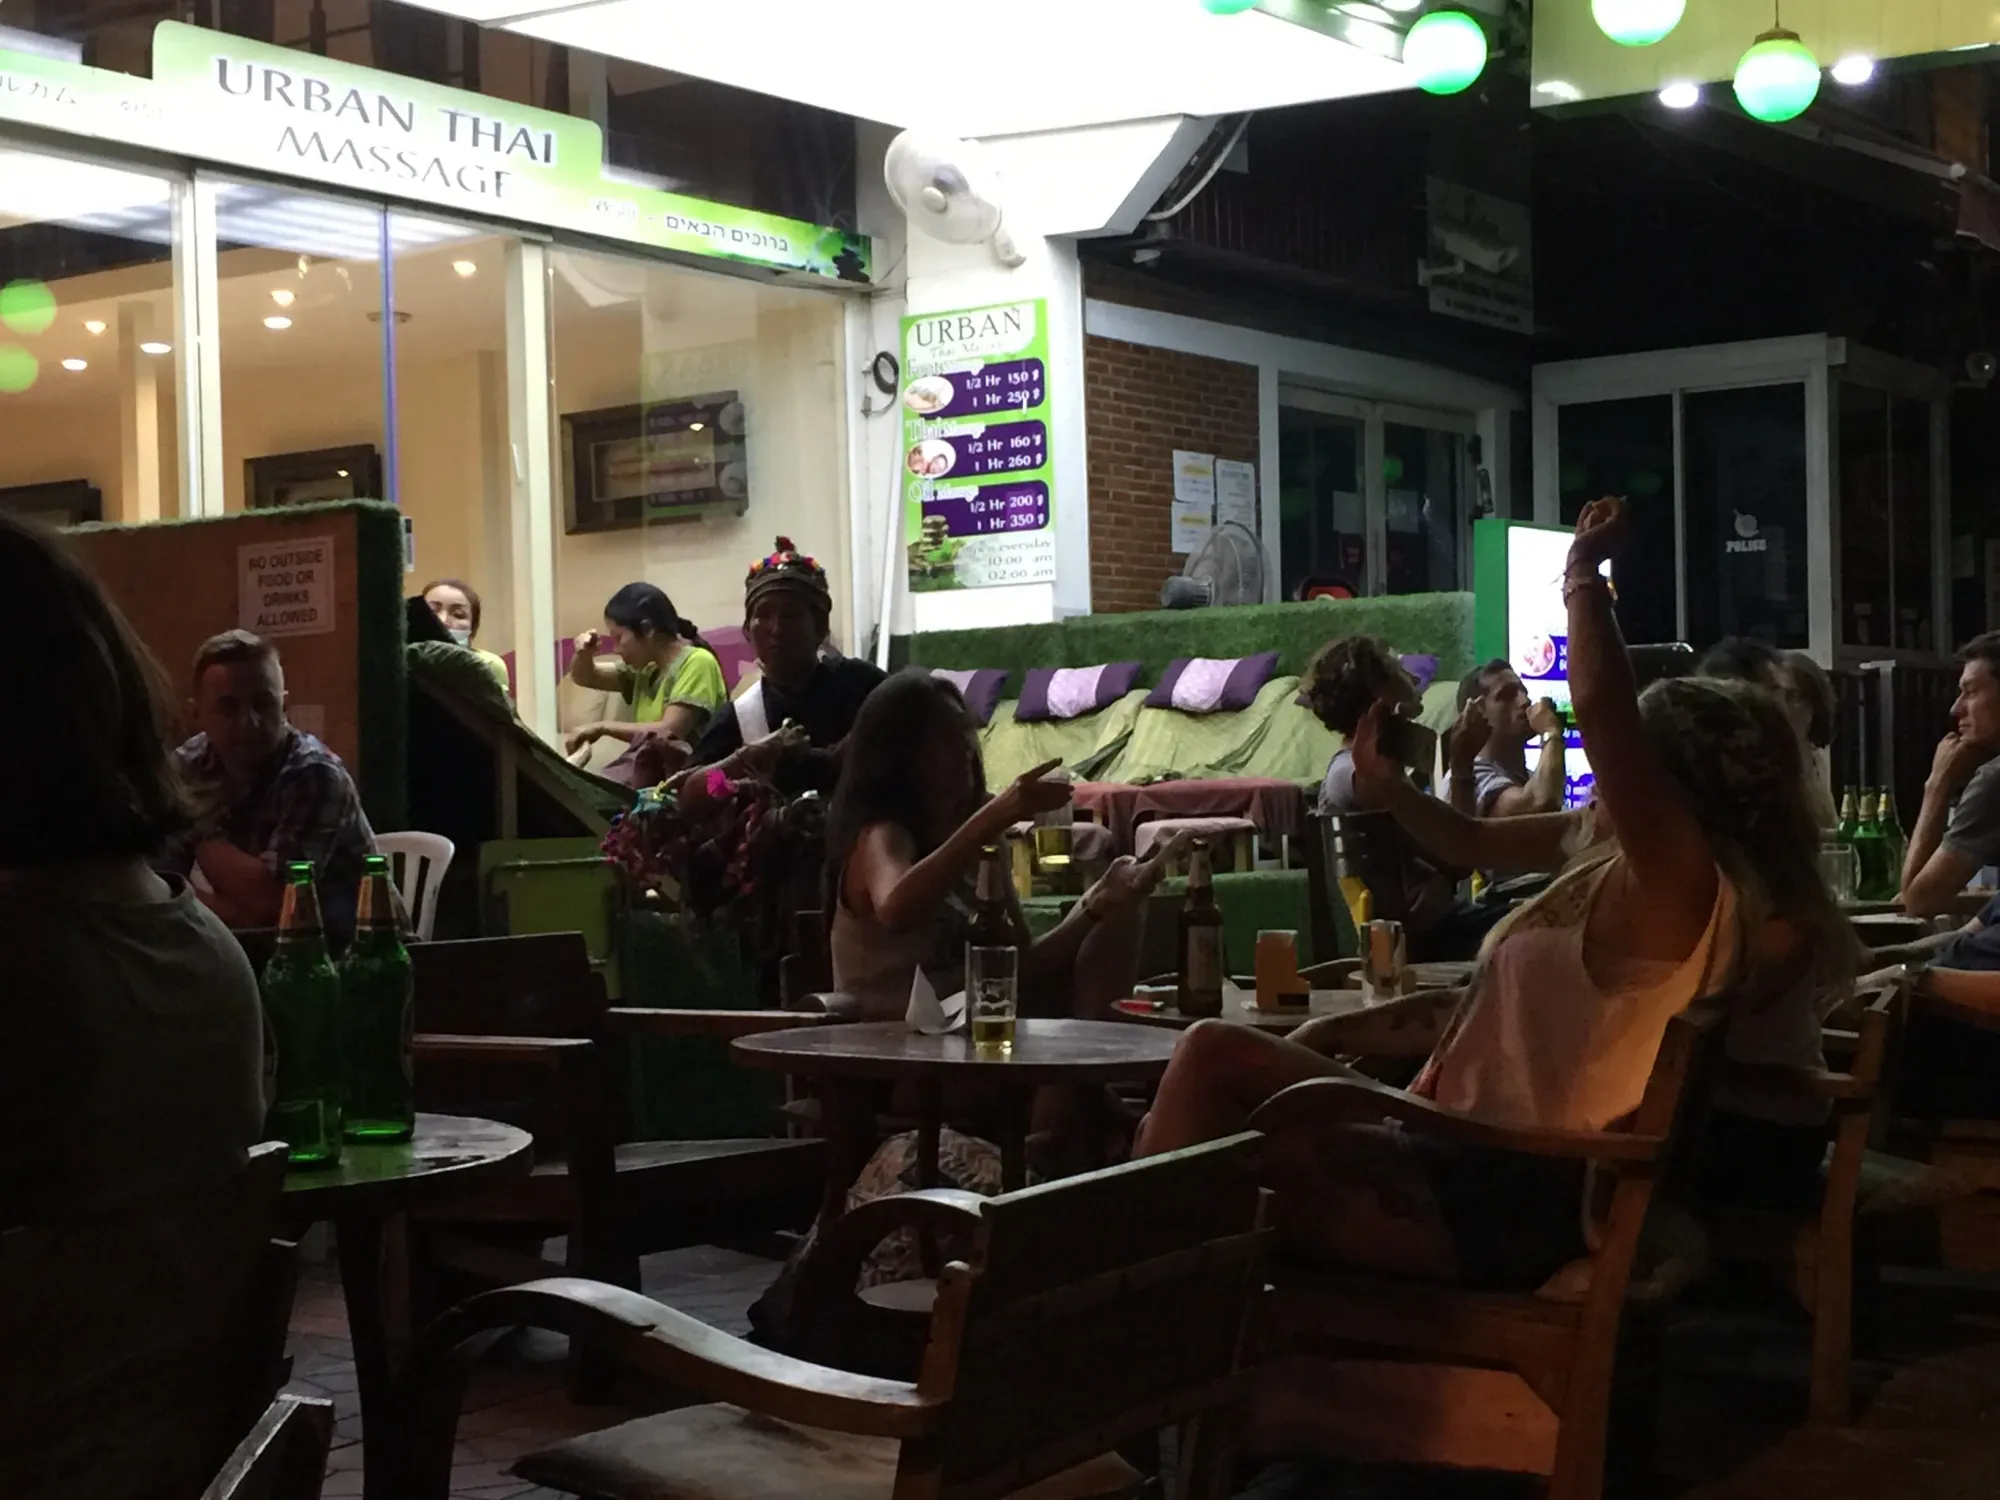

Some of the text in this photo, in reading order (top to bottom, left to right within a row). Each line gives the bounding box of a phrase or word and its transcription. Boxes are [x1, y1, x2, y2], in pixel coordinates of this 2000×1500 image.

[216, 57, 554, 165] URBAN THAI
[666, 214, 789, 252] ברוכים הבאים
[915, 306, 1022, 347] URBAN
[966, 378, 982, 390] 1/2
[985, 374, 1001, 387] Hr
[1008, 371, 1029, 385] 150
[973, 396, 978, 408] 1
[985, 393, 1002, 406] Hr
[1007, 389, 1030, 404] 250
[968, 442, 983, 454] 1/2
[987, 439, 1003, 452] Hr
[1010, 436, 1031, 449] 160
[975, 460, 980, 472] 1
[988, 457, 1004, 470] Hr
[1008, 455, 1032, 468] 260
[970, 501, 986, 513] 1/2
[989, 498, 1006, 511] Hr
[1010, 494, 1033, 508] 200
[977, 520, 982, 531] 1
[990, 517, 1006, 530] Hr
[1010, 513, 1034, 528] 350
[248, 548, 324, 572] NO OUTSIDE
[258, 569, 315, 588] FOOD OR
[263, 589, 311, 608] DRINKS
[256, 607, 318, 627] ALLOWED
